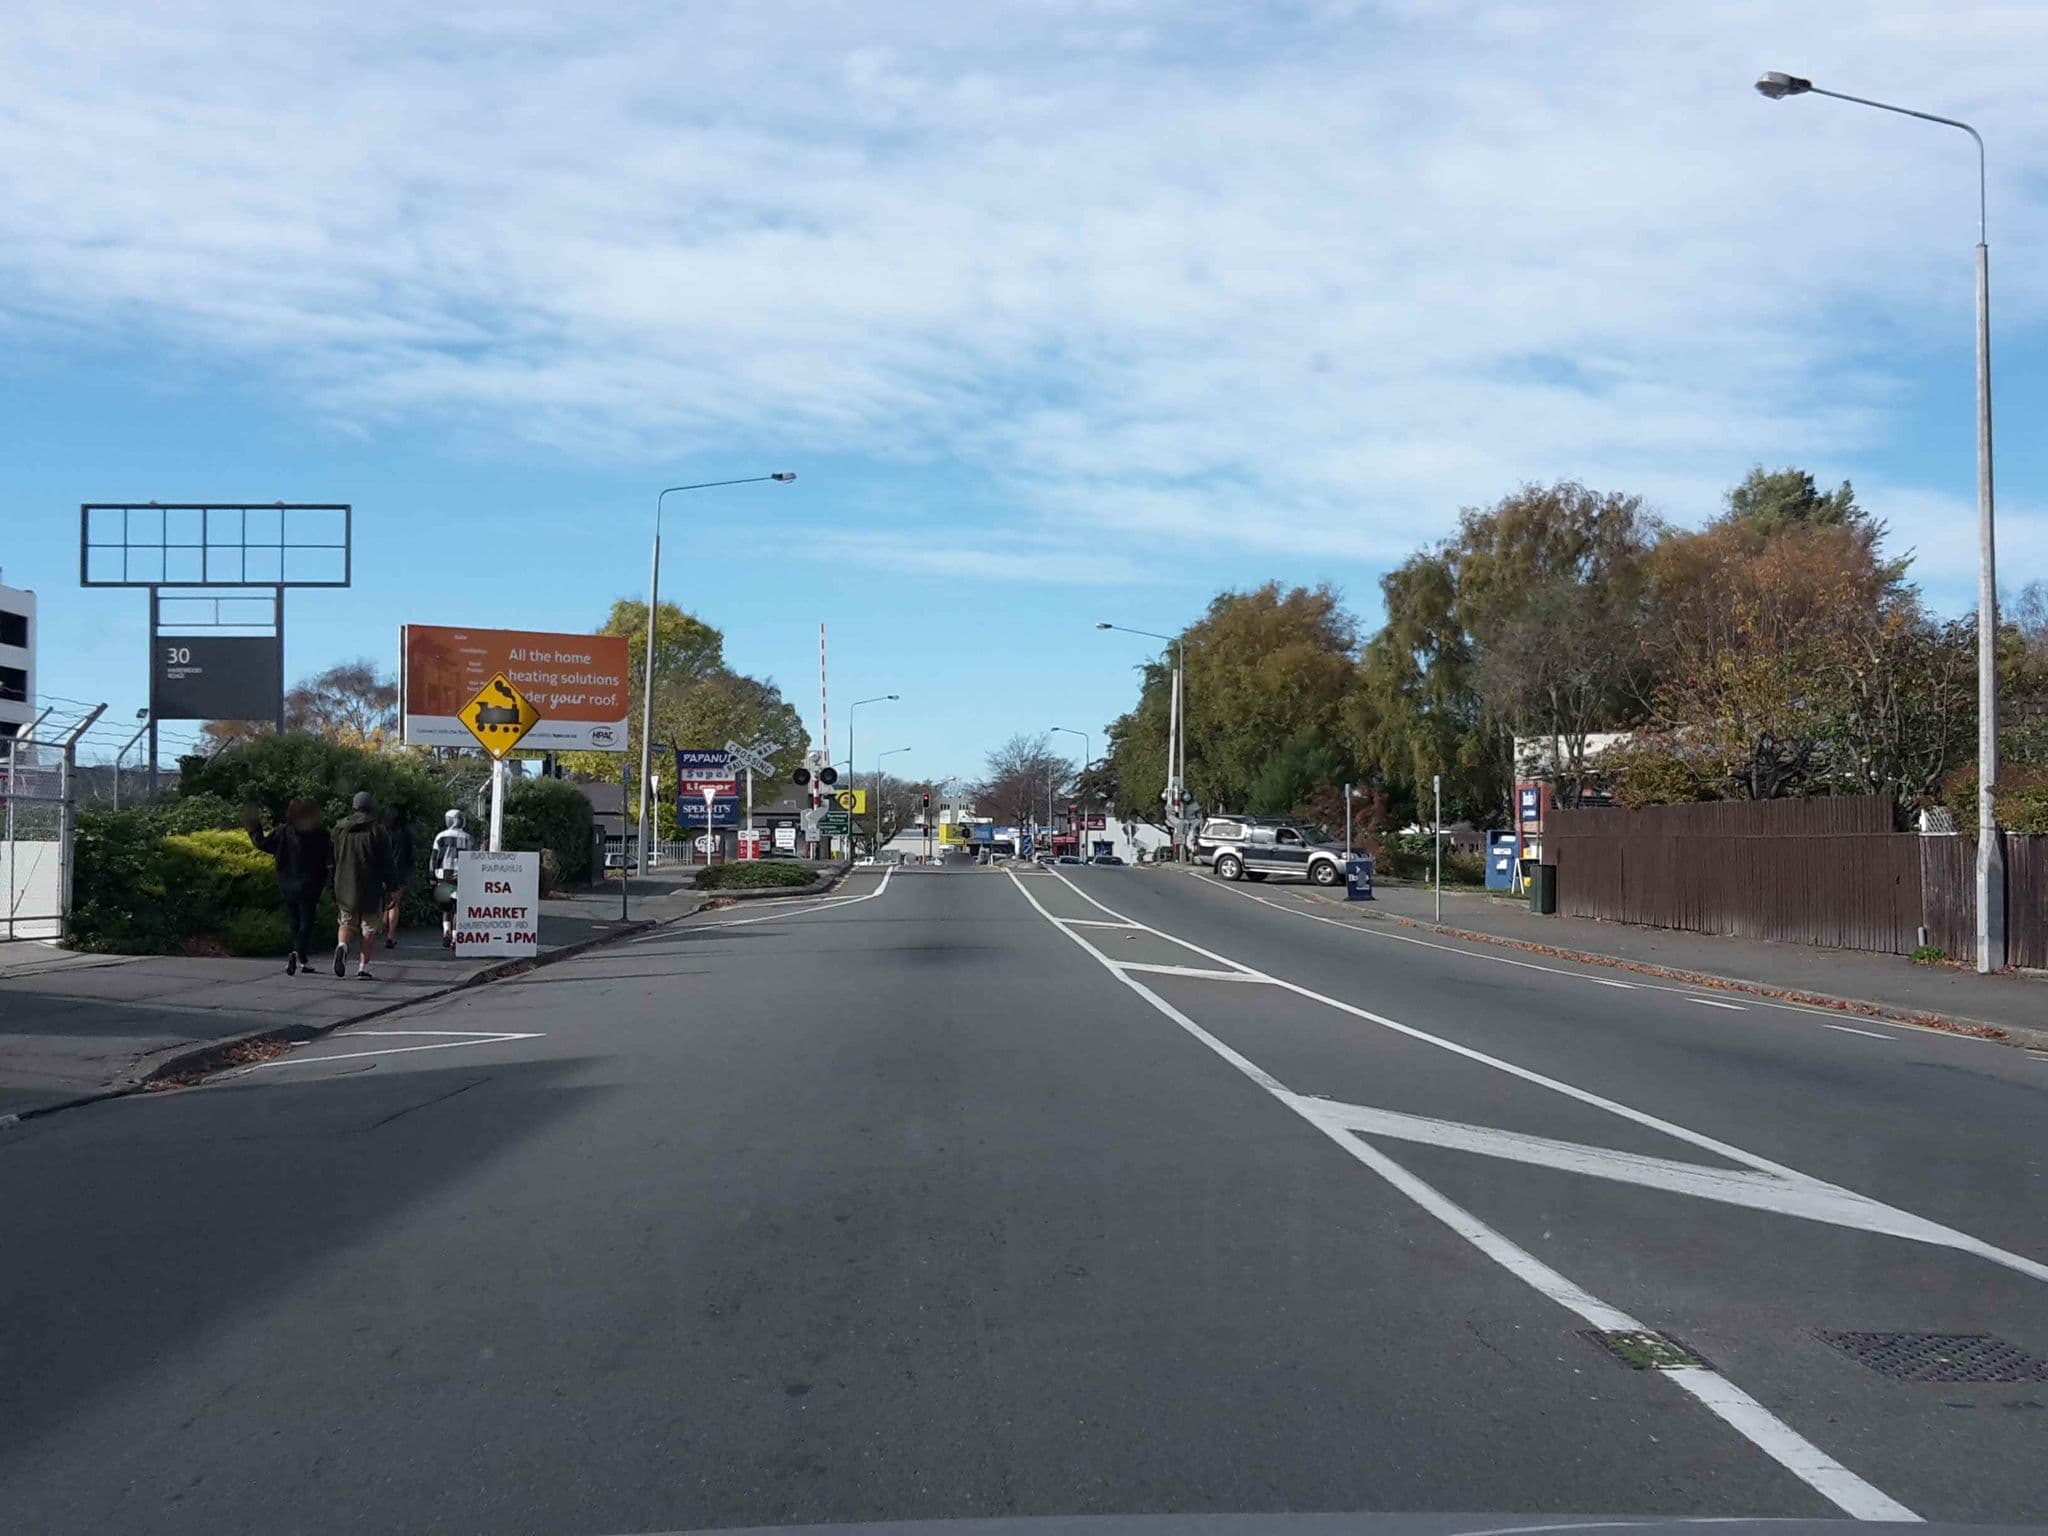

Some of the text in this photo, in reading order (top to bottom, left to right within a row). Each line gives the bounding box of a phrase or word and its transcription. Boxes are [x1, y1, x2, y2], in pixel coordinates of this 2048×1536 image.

[167, 647, 190, 665] 30
[508, 649, 591, 664] All the home
[508, 669, 619, 686] heating solutions
[524, 690, 619, 709] der your roof.
[683, 753, 732, 763] PAPANUI
[726, 744, 774, 773] RAIL WAY
[728, 743, 772, 775] CROSSING
[484, 881, 512, 894] RSA
[468, 906, 528, 919] MARKET
[456, 931, 489, 944] 8AM
[505, 931, 537, 944] 1PM
